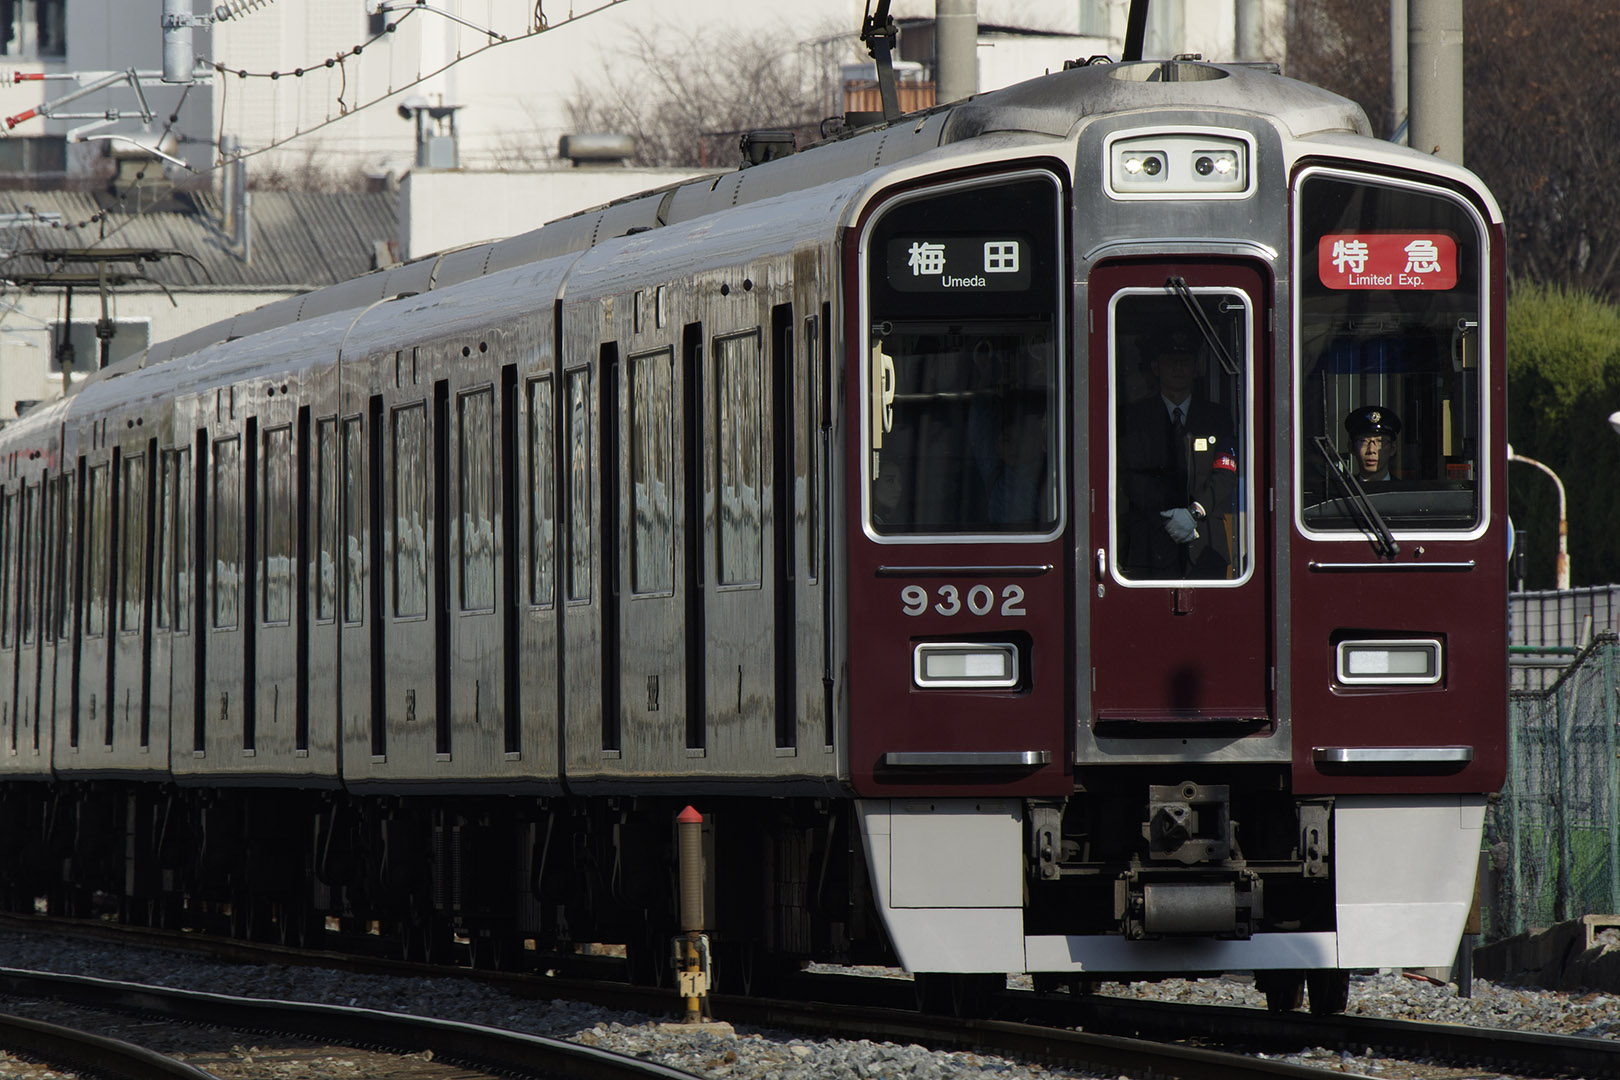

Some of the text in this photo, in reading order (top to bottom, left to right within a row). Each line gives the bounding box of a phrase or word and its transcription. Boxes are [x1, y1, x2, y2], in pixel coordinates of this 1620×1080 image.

[908, 241, 1019, 276] 梅田
[1332, 240, 1441, 273] 特急
[942, 275, 986, 287] Umeda
[1348, 274, 1424, 287] Limited Exp.
[901, 584, 1026, 616] 9302
[688, 975, 696, 993] 1
